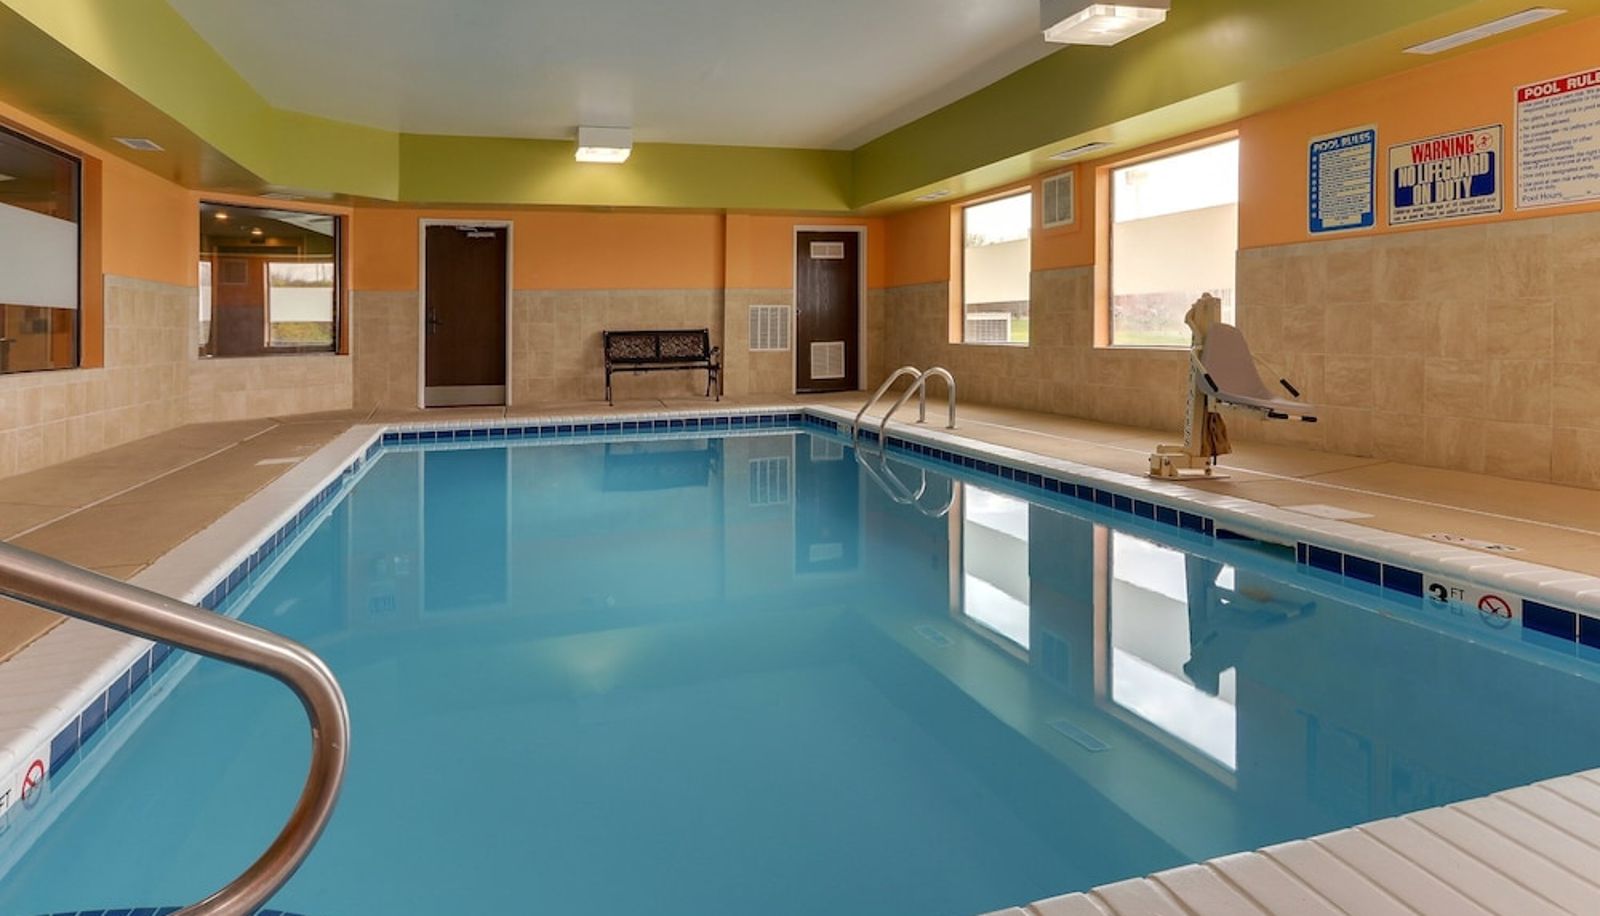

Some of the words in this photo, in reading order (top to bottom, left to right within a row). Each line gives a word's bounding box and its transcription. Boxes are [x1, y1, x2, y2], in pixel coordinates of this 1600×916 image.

[1524, 82, 1561, 99] POOL
[1411, 134, 1475, 163] WARNING
[1398, 165, 1416, 189] NO
[1418, 152, 1489, 184] LIFEGUARD
[1413, 183, 1431, 205] ON
[1435, 176, 1473, 203] DUTY
[1429, 583, 1448, 603] 3
[1451, 587, 1465, 600] FT
